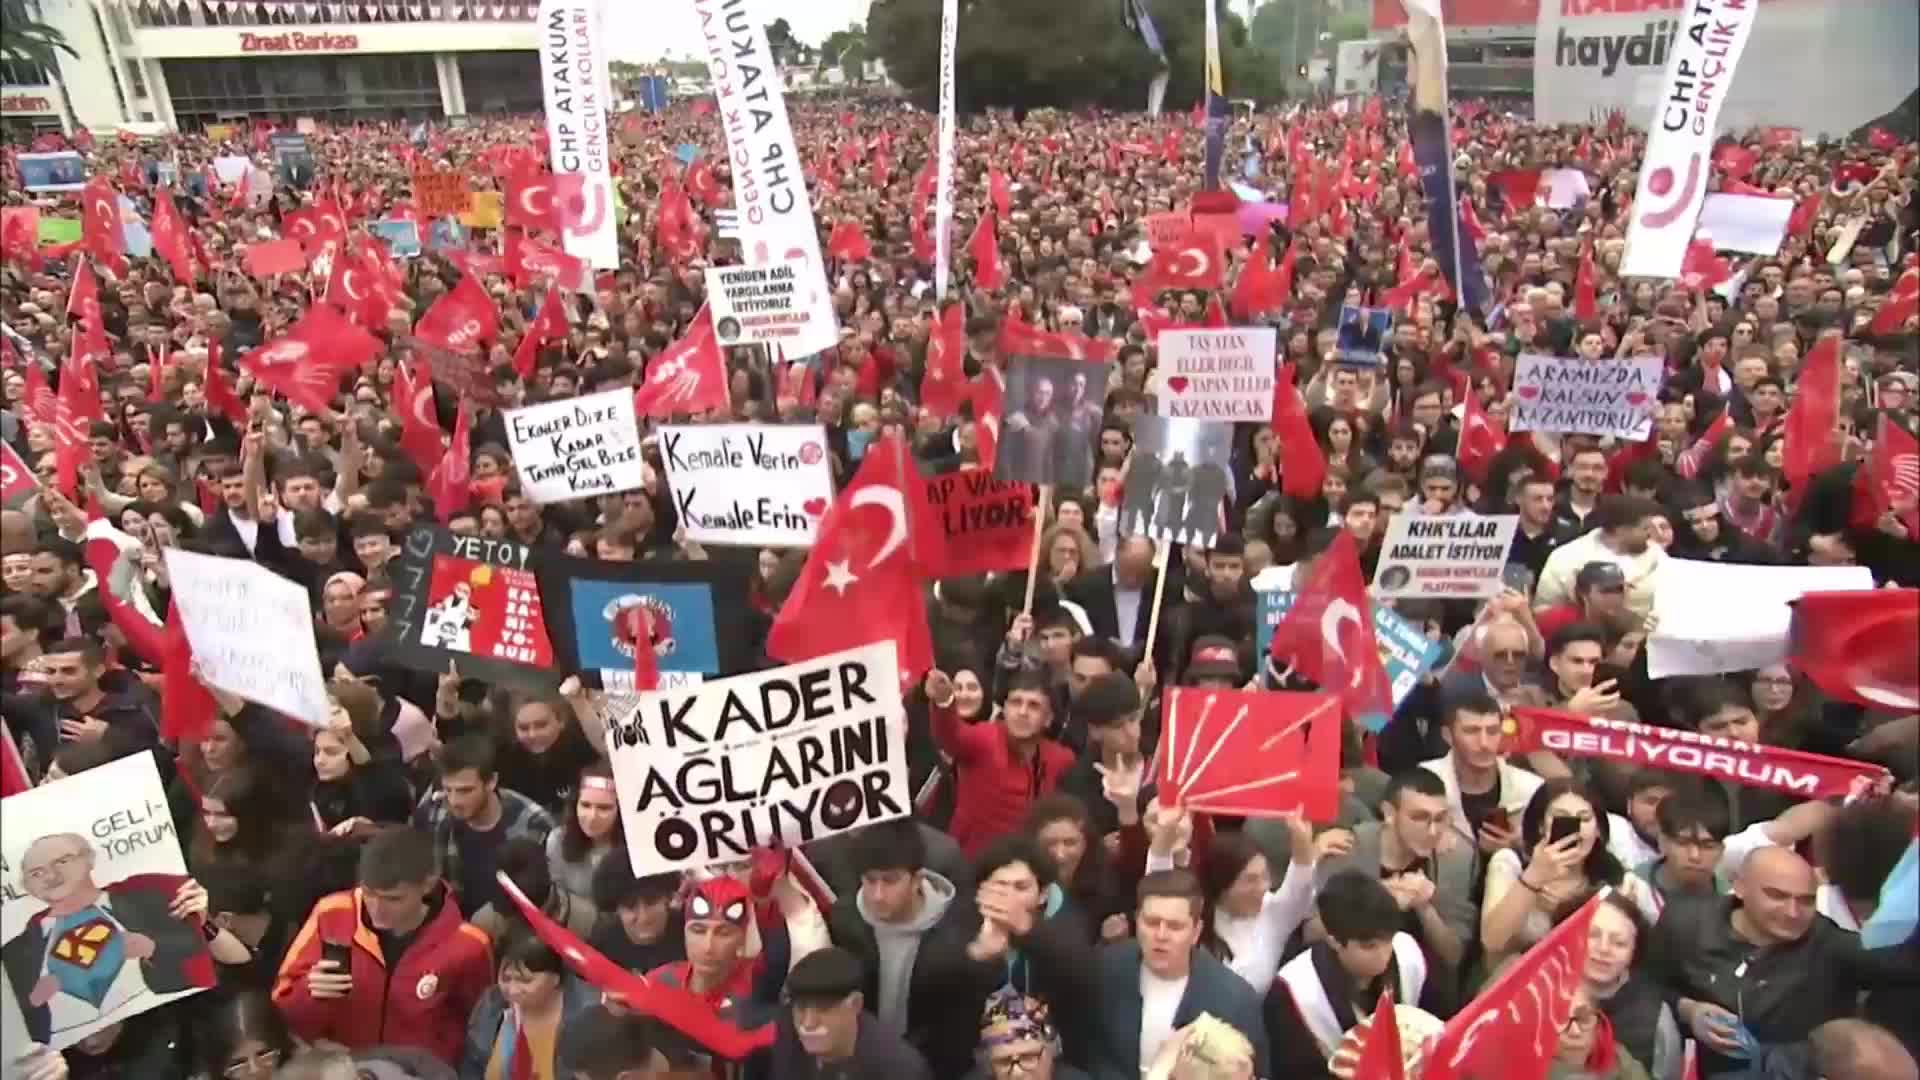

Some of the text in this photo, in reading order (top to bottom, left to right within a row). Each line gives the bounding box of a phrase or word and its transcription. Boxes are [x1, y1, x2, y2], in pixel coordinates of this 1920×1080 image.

[239, 31, 359, 51] Ziraat Bankası
[573, 8, 593, 86] KOLLARI
[1663, 0, 1713, 132] CHP AT
[1692, 19, 1740, 136] GENÇLİK
[548, 8, 581, 173] CHP ATAKUM
[719, 265, 796, 285] YENİDEN ADİL
[725, 282, 794, 298] YARGILANMA
[1528, 364, 1642, 384] ARAMIZDA
[1170, 399, 1265, 417] KAZANACAK
[747, 432, 799, 470] Verin
[757, 498, 808, 531] Erin
[1408, 520, 1497, 537] KHK'LILAR
[1390, 541, 1504, 559] ADALET İSTİYOR
[660, 662, 876, 748] KADER
[637, 716, 888, 812] AĞLARINI
[1541, 728, 1820, 793] GELİYORUM
[654, 770, 903, 860] ÖRÜYOR
[100, 821, 174, 861] YORUM
